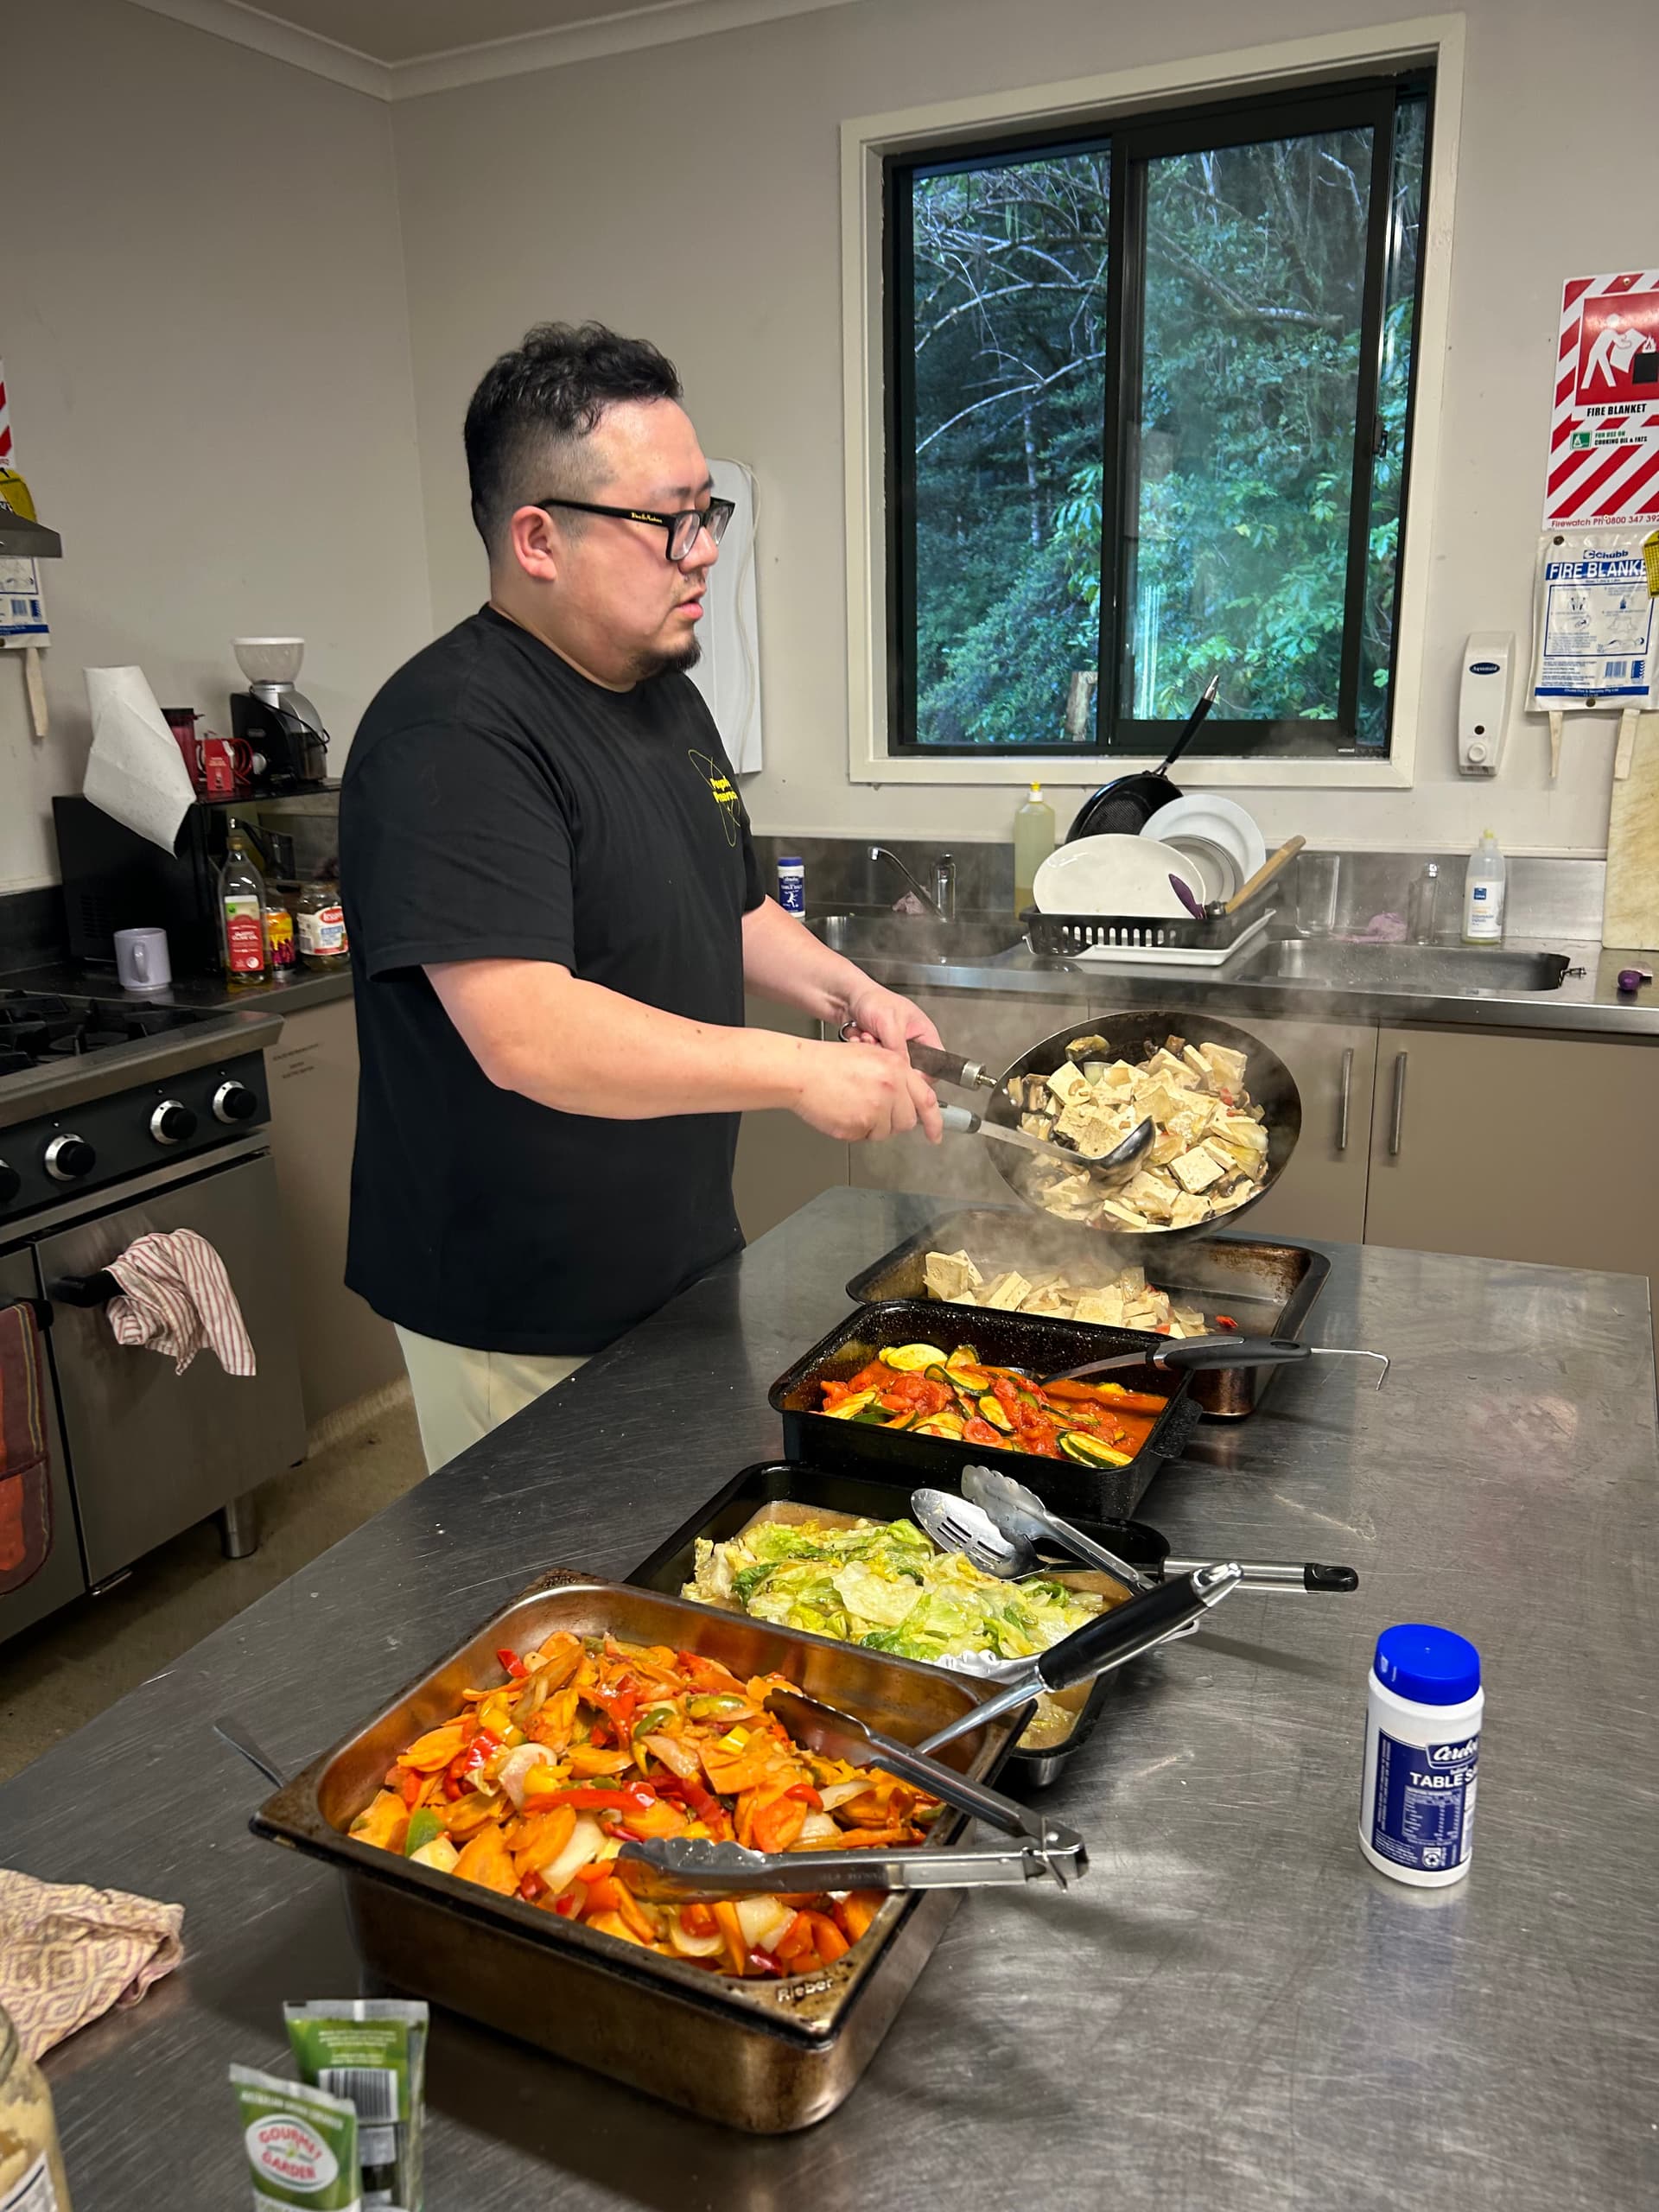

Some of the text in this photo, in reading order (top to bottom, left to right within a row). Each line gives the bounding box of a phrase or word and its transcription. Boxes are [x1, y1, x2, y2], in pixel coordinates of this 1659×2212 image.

[1586, 404, 1647, 416] FIRE BLANKET
[1552, 518, 1591, 527] Firewatch
[1605, 516, 1626, 524] 0800
[1629, 515, 1643, 524] 347
[1595, 550, 1629, 559] Chubb
[1549, 559, 1646, 580] FIRE BLANKE
[1409, 1771, 1464, 1788] TABLE
[258, 2126, 323, 2159] GOURMET
[262, 2151, 316, 2179] GARDEN
